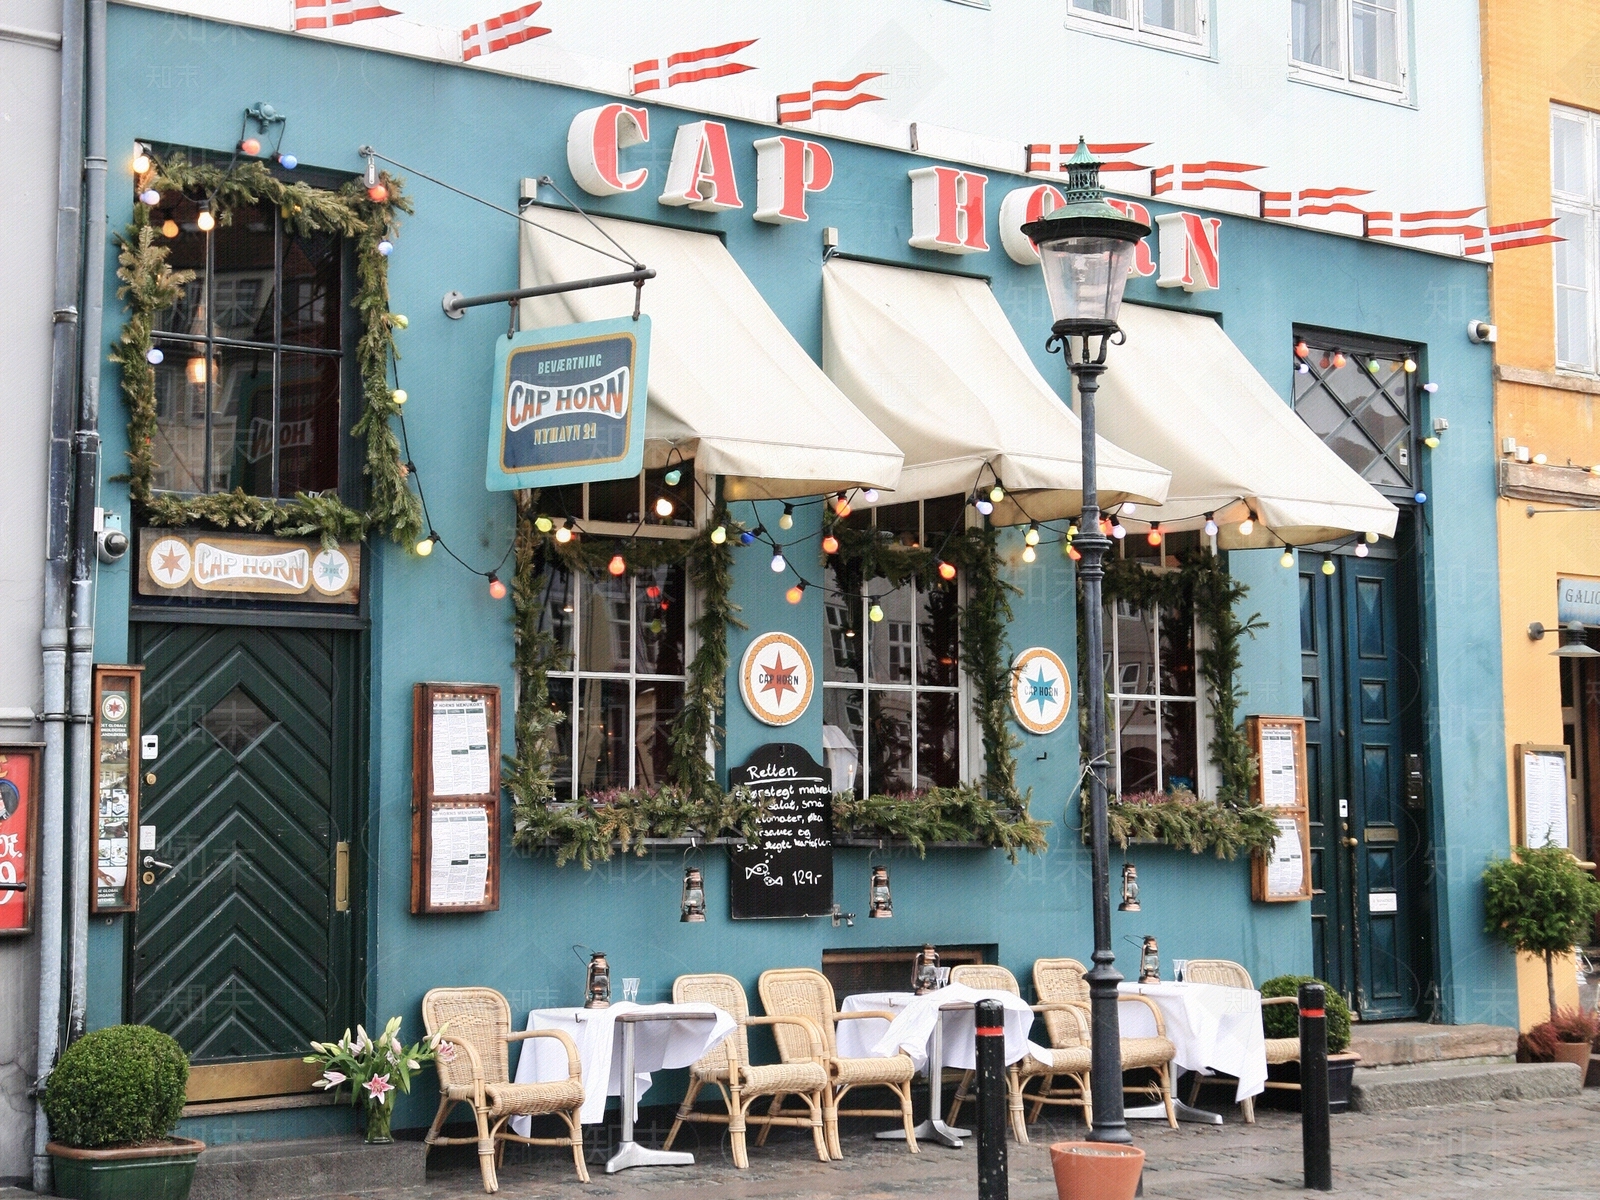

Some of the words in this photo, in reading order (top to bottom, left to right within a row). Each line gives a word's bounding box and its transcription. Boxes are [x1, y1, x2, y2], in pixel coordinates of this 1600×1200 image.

[567, 103, 834, 226] CAP
[537, 353, 602, 375] BEVÆRTNING
[510, 384, 551, 427] CAP
[555, 369, 627, 416] HORN
[533, 424, 582, 446] NYHAVN
[582, 422, 598, 440] 21
[197, 549, 238, 580] CAP
[242, 549, 306, 588] HORN
[758, 673, 775, 684] CAP
[776, 674, 799, 686] HORN
[1024, 685, 1038, 696] CAP
[1039, 687, 1059, 697] HORN
